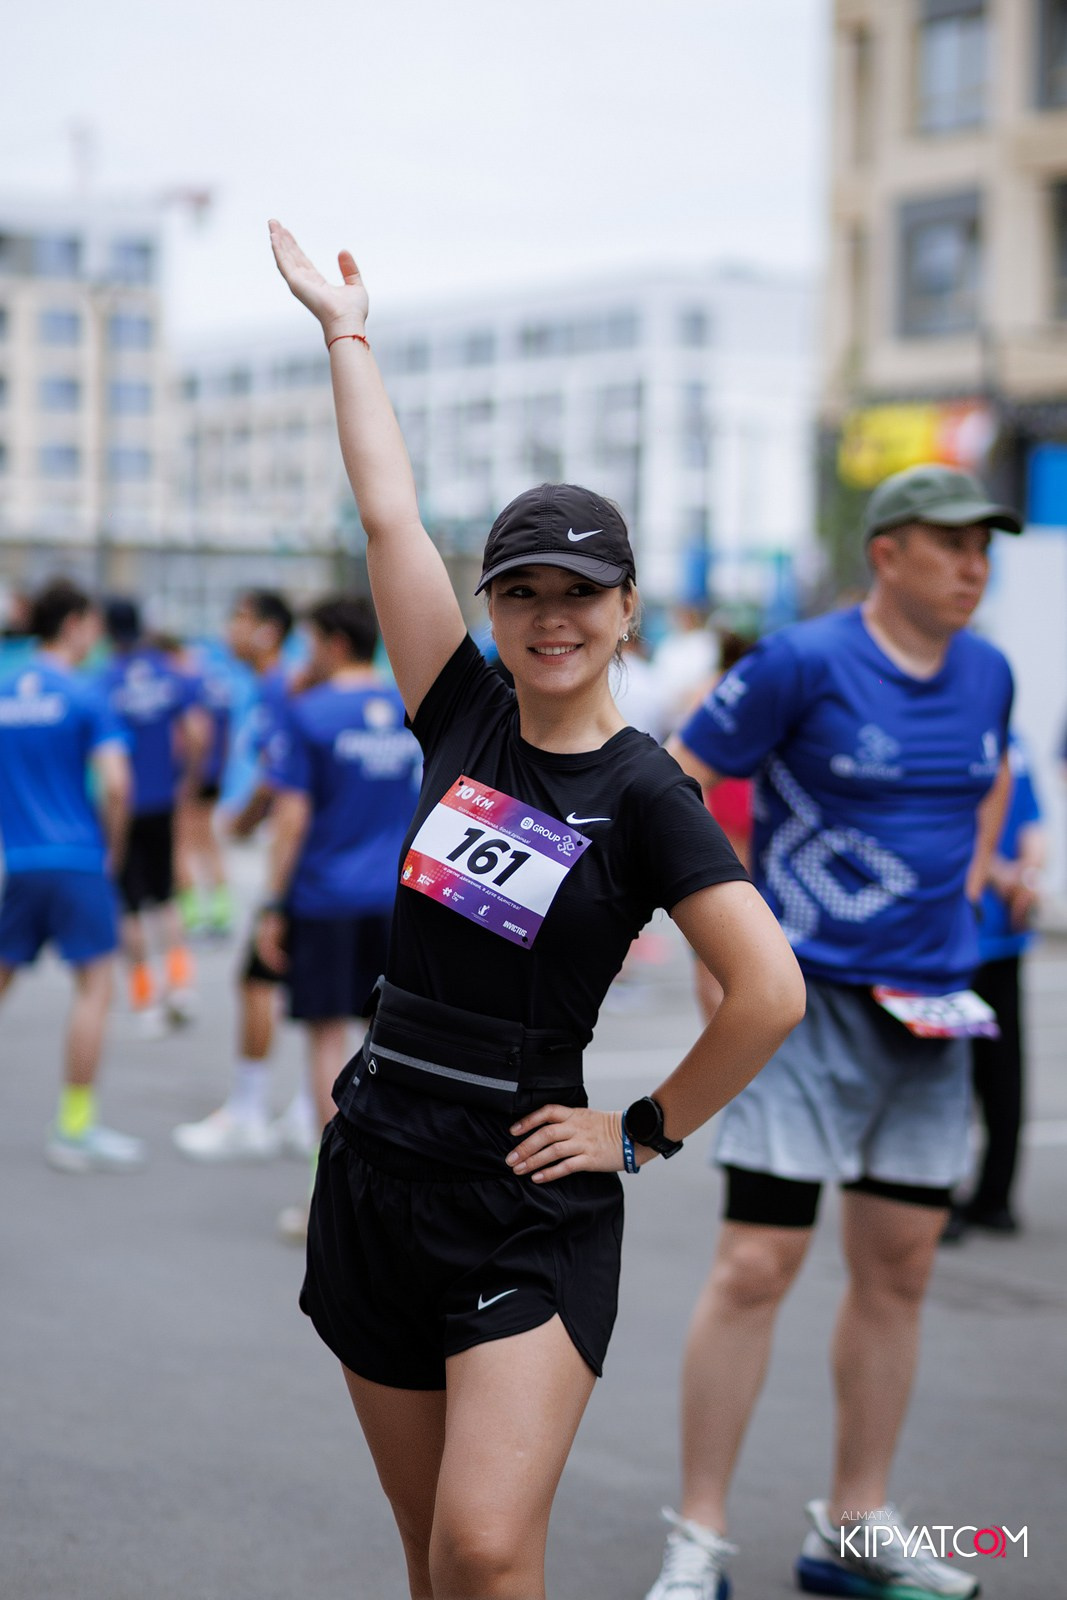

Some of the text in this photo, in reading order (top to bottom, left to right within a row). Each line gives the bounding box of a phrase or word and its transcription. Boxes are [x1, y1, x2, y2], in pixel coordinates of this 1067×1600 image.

[455, 785, 475, 800] 10
[532, 824, 561, 842] GROUP
[445, 827, 532, 887] 161
[502, 920, 528, 937] INVICTUS
